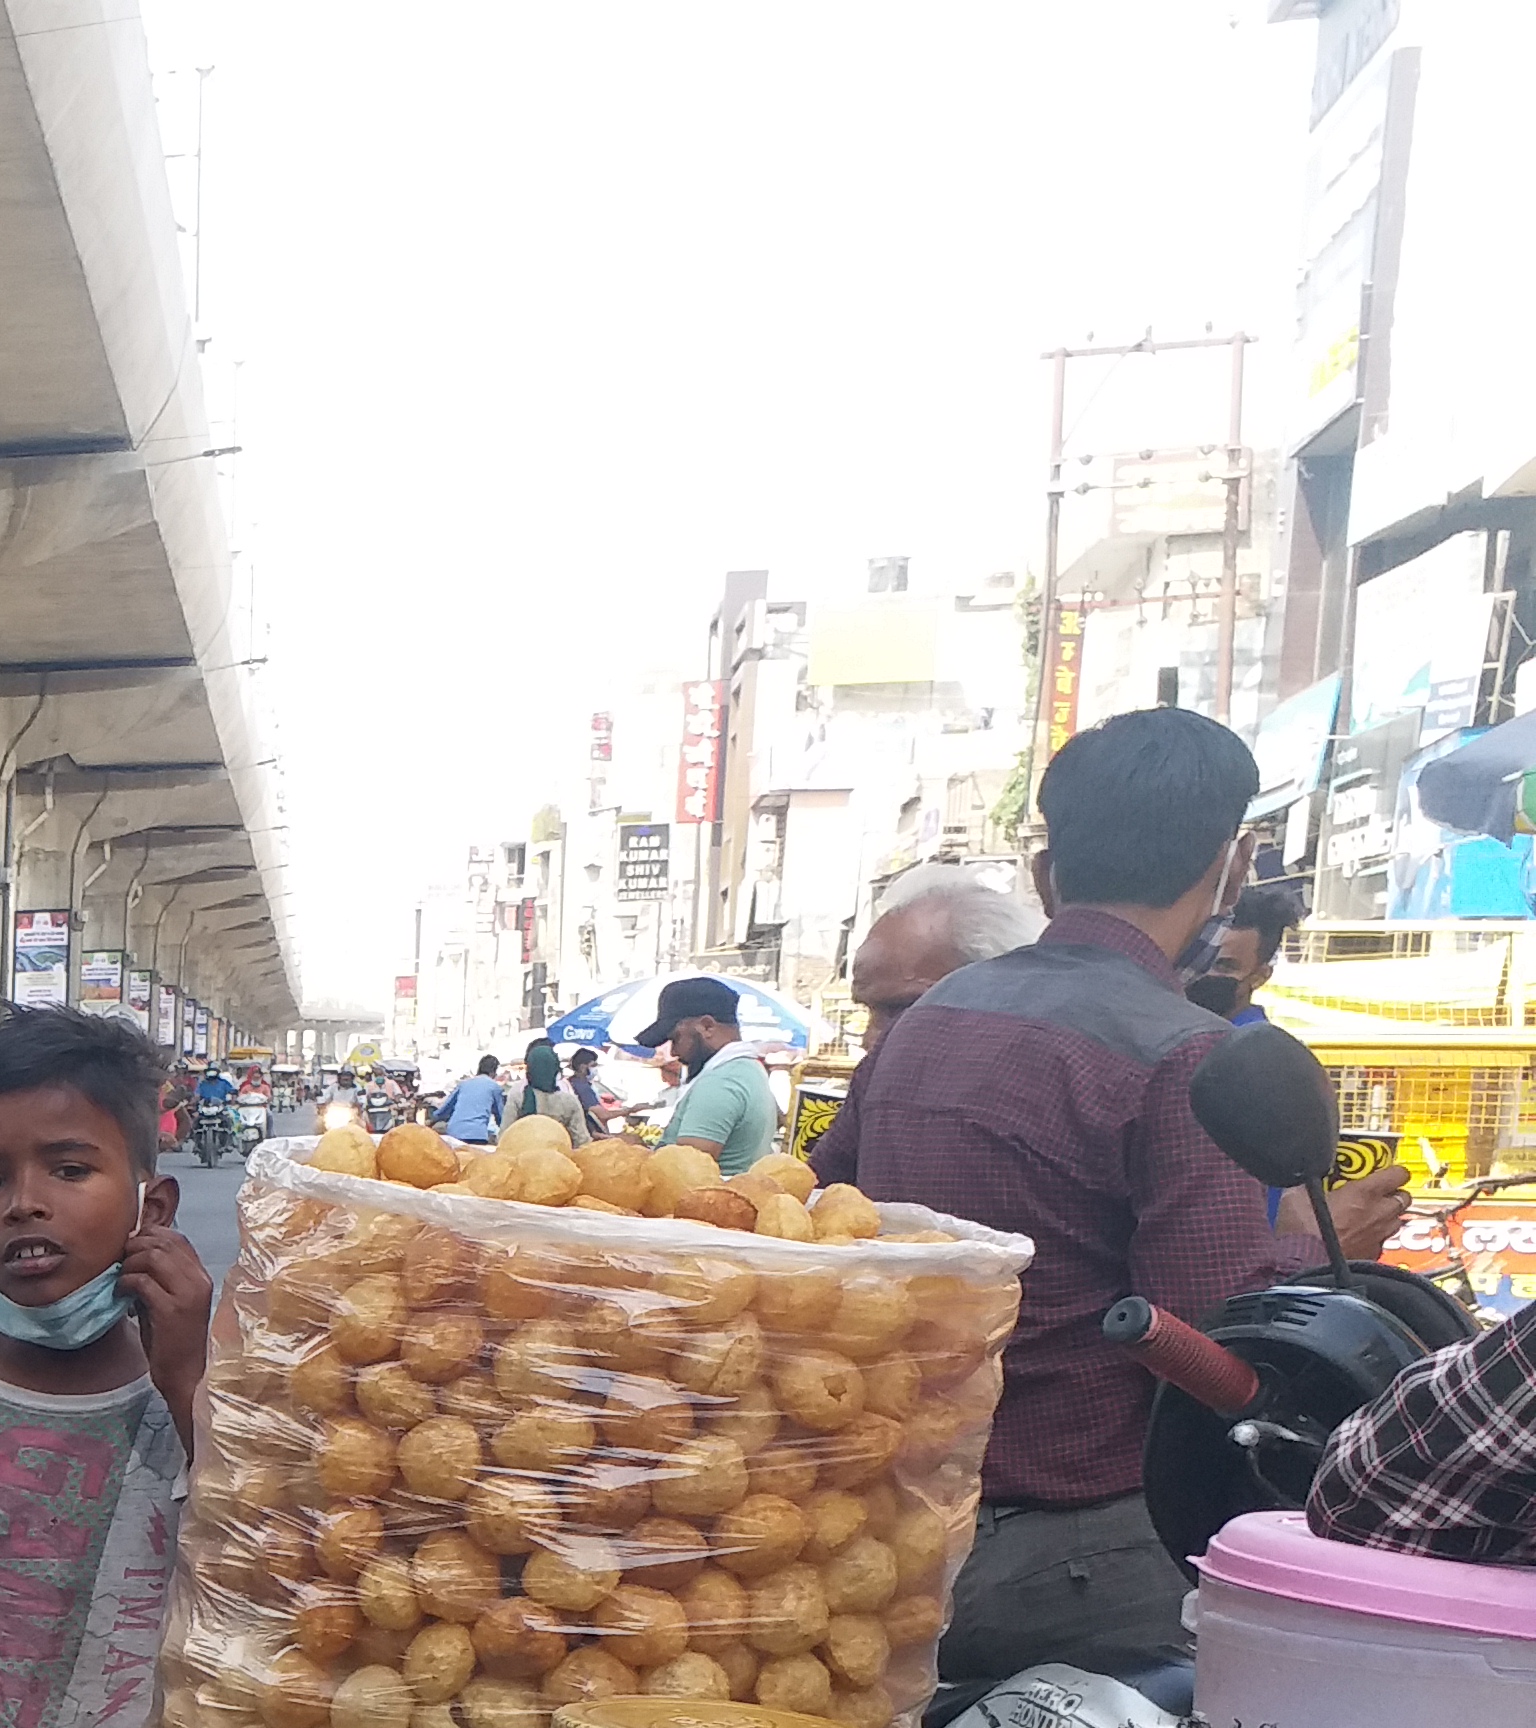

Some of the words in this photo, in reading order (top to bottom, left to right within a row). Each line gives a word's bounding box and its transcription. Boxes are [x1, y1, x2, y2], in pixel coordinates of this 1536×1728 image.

[619, 849, 669, 862] KUMAR
[626, 864, 660, 877] SHIV
[619, 878, 668, 890] KUMAR
[726, 964, 771, 976] JOCKEY
[122, 1567, 166, 1631] I'M
[101, 1644, 153, 1676] A
